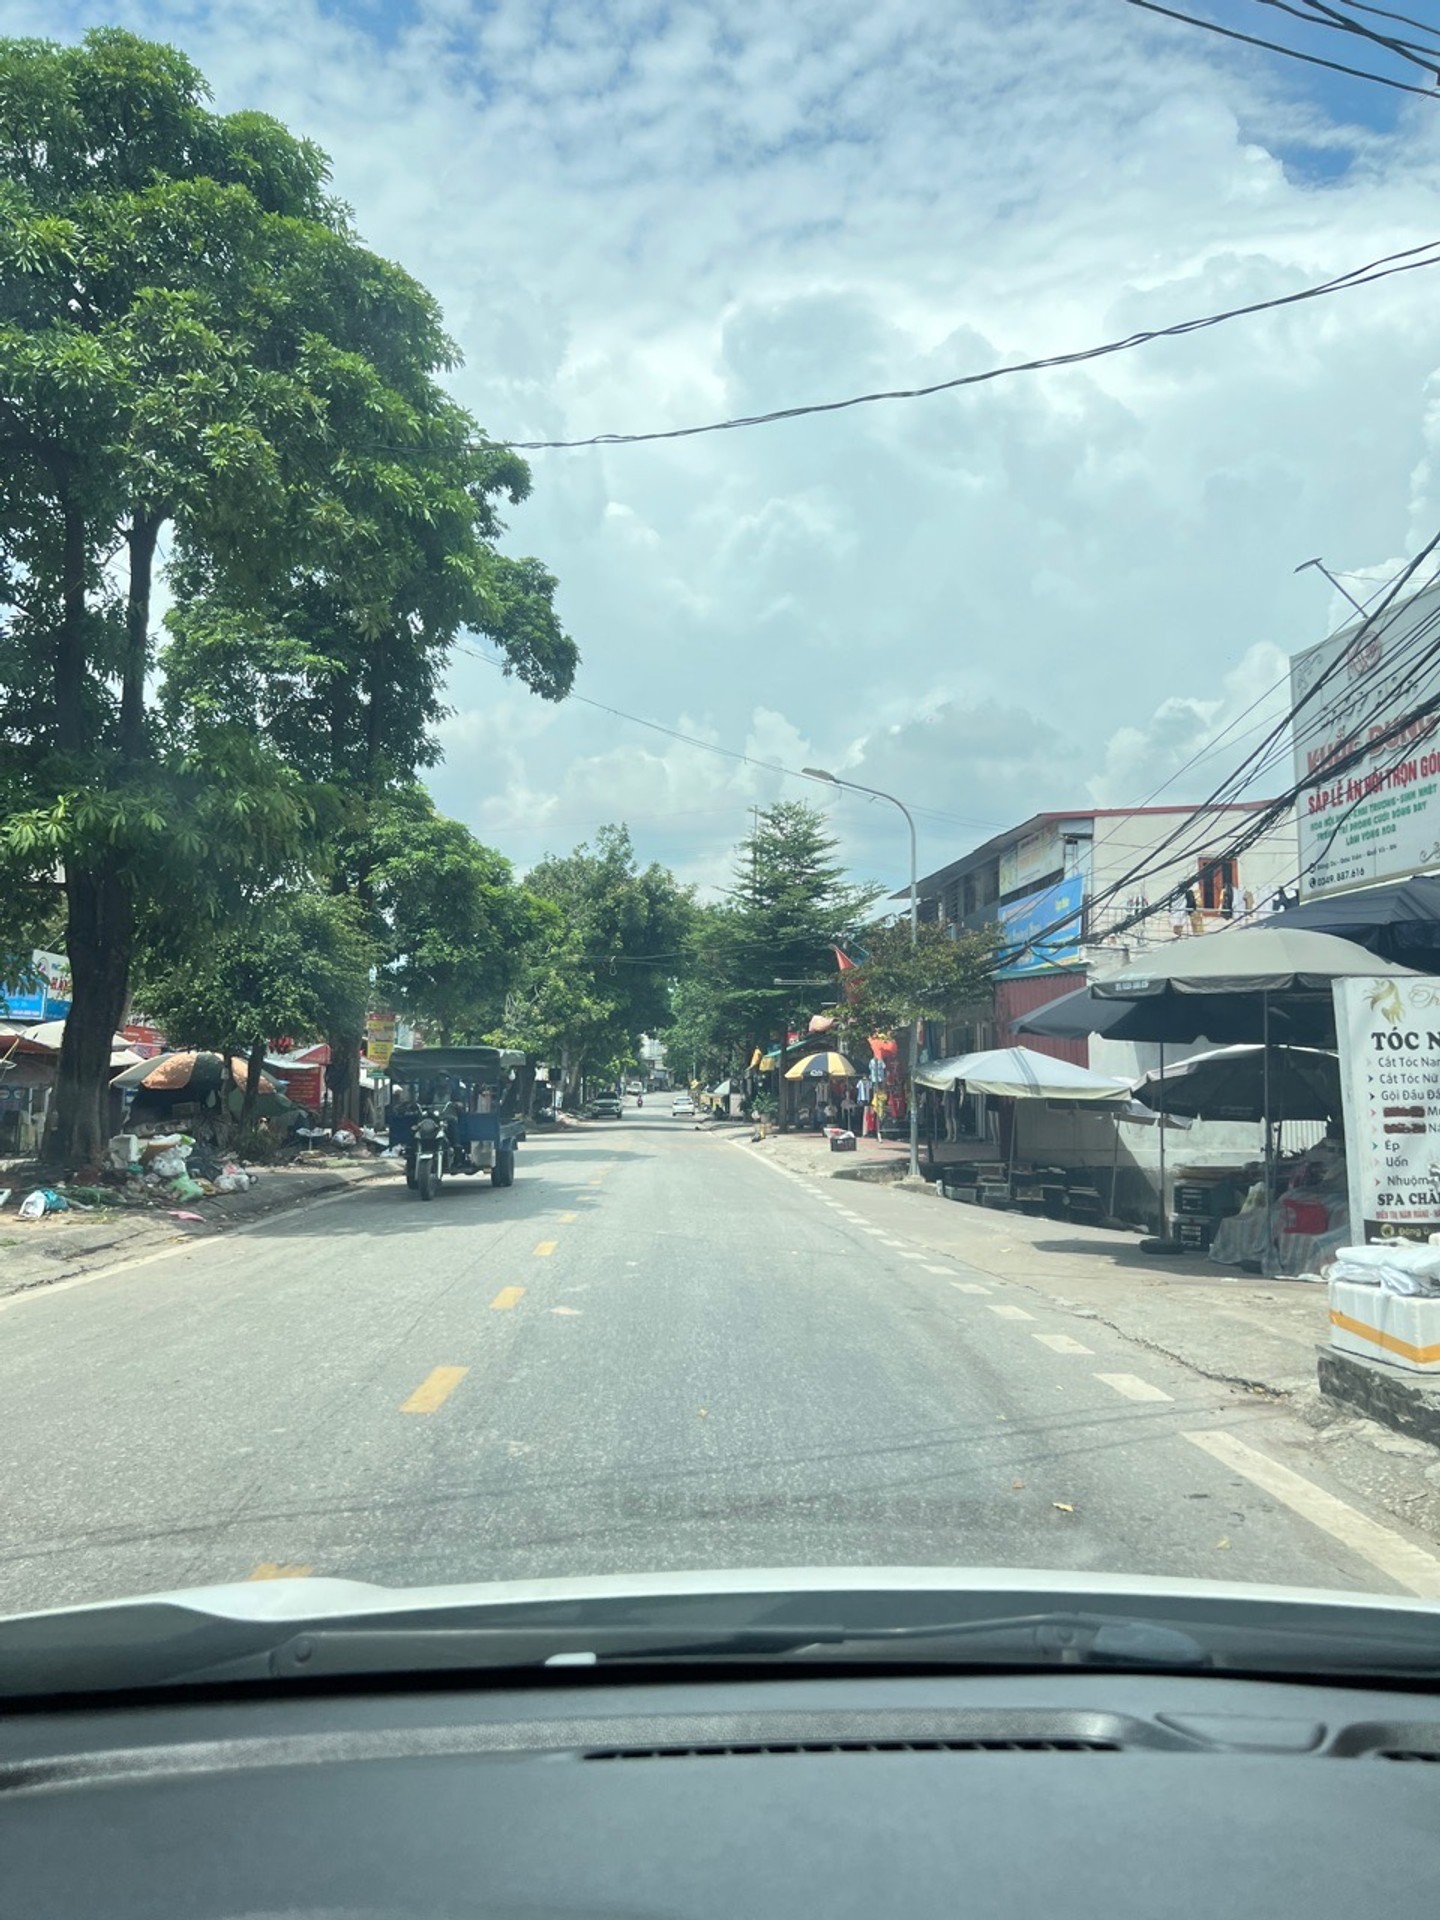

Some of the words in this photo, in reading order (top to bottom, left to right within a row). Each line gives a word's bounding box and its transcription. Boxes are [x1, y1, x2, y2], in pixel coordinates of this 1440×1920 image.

[1371, 1026, 1420, 1051] TÓC
[1385, 1156, 1408, 1168] Uốn
[1377, 1192, 1405, 1206] SPA
